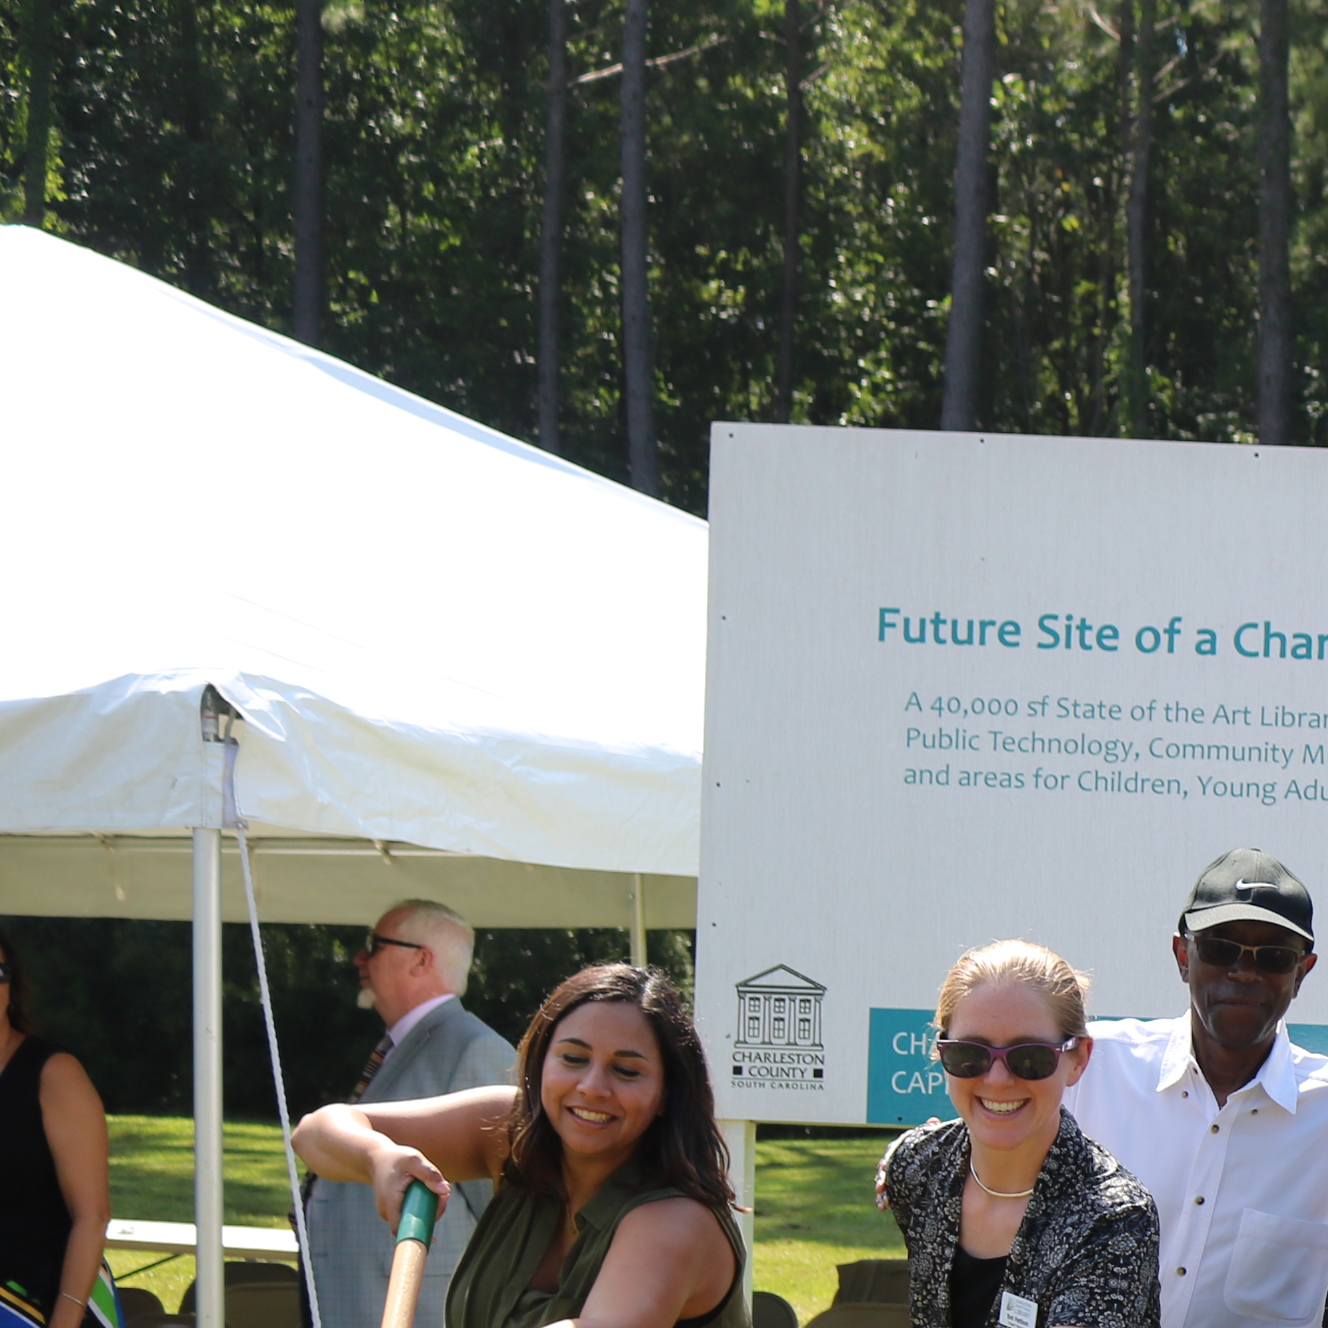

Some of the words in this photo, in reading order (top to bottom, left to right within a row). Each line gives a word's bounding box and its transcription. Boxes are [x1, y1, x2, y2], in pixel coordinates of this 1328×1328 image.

[878, 607, 1022, 648] Future
[1036, 613, 1120, 652] Site
[1135, 616, 1183, 654] of
[1195, 628, 1217, 656] a
[905, 692, 923, 712] A
[930, 696, 1018, 718] 40,000
[1027, 695, 1049, 717] sf
[1057, 697, 1122, 720] State
[1130, 699, 1157, 721] of
[1164, 701, 1205, 724] the
[1212, 704, 1251, 726] Art
[907, 727, 980, 751] Public
[988, 731, 1140, 764] Technology,
[1149, 737, 1294, 769] Community
[904, 764, 950, 786] and
[958, 771, 1025, 789] areas
[1033, 767, 1070, 790] for
[1078, 770, 1188, 799] Children,
[1197, 776, 1277, 806] Young
[732, 1051, 825, 1065] CHARLESTON
[749, 1066, 807, 1078] COUNTY
[731, 1080, 766, 1088] SOUTH
[771, 1081, 824, 1090] CAROLINA
